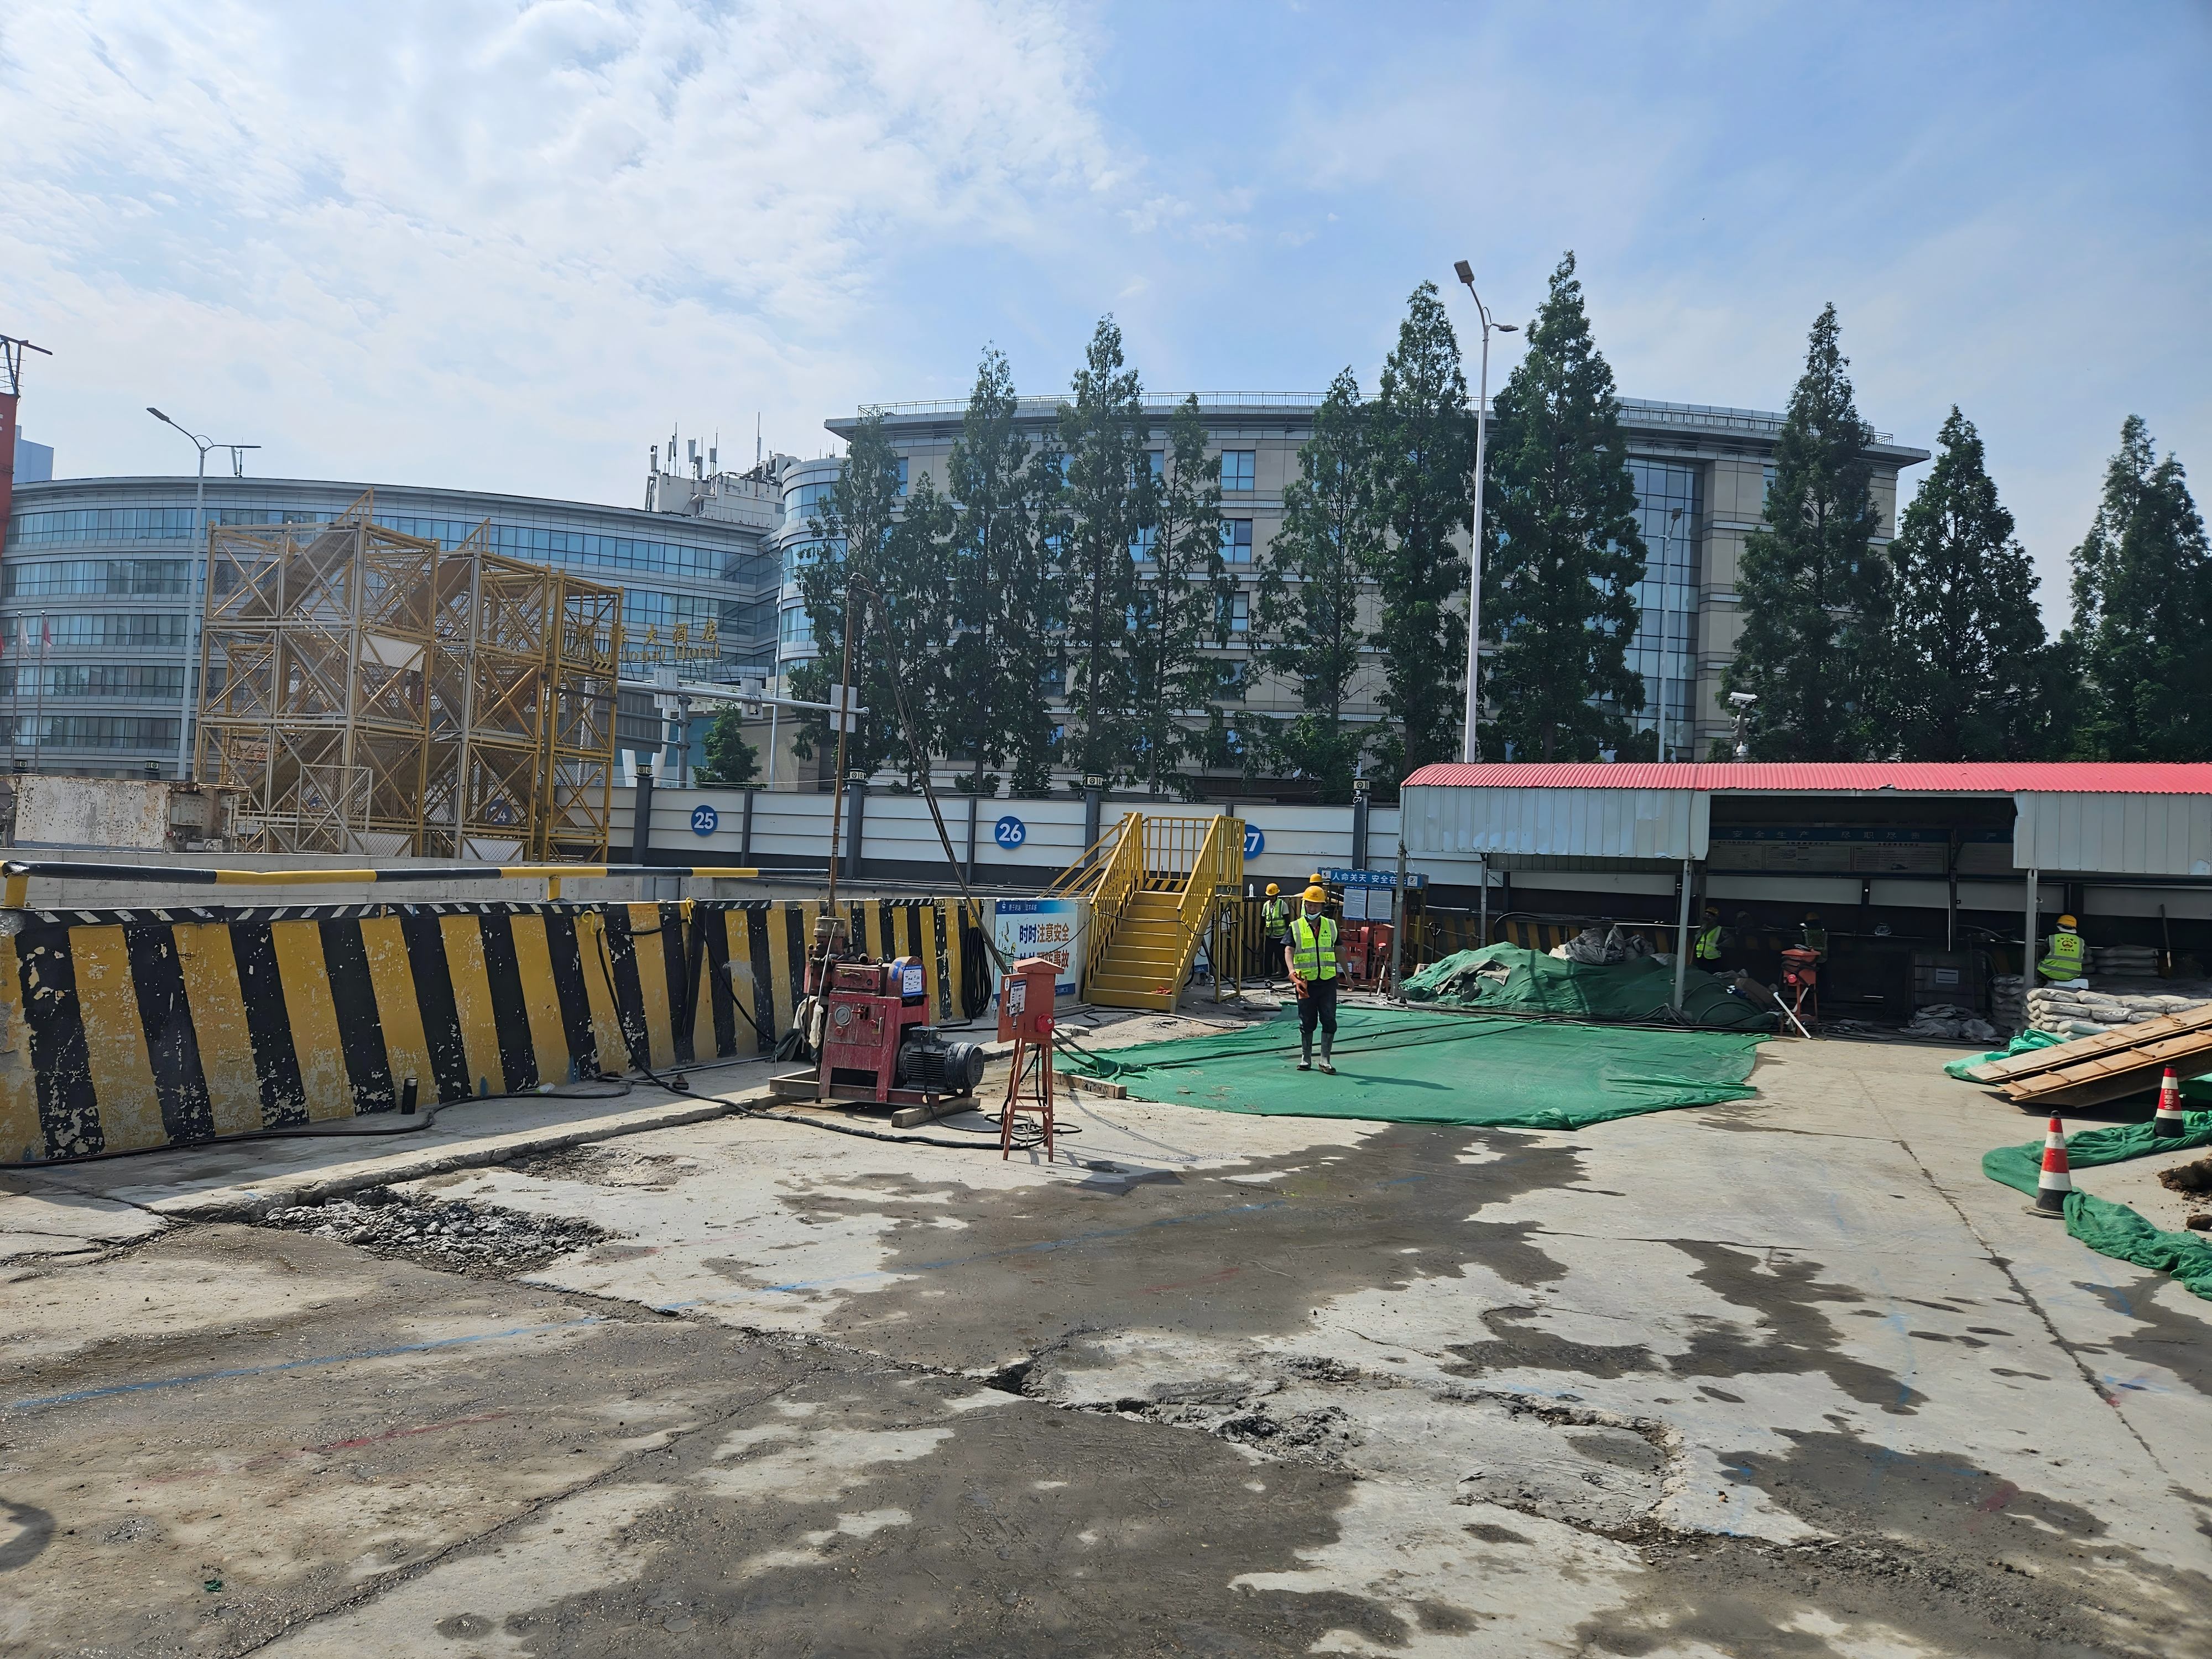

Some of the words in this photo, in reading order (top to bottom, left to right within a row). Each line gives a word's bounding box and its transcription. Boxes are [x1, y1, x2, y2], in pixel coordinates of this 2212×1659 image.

[675, 643, 721, 660] Hotel
[694, 812, 714, 830] 25
[999, 823, 1022, 842] 26
[1840, 831, 1921, 839] 尽职尽责
[1244, 833, 1260, 852] 7
[1332, 873, 1366, 883] 人命关天
[1371, 875, 1406, 885] 安全在
[1020, 922, 1069, 945] 时时注意安全
